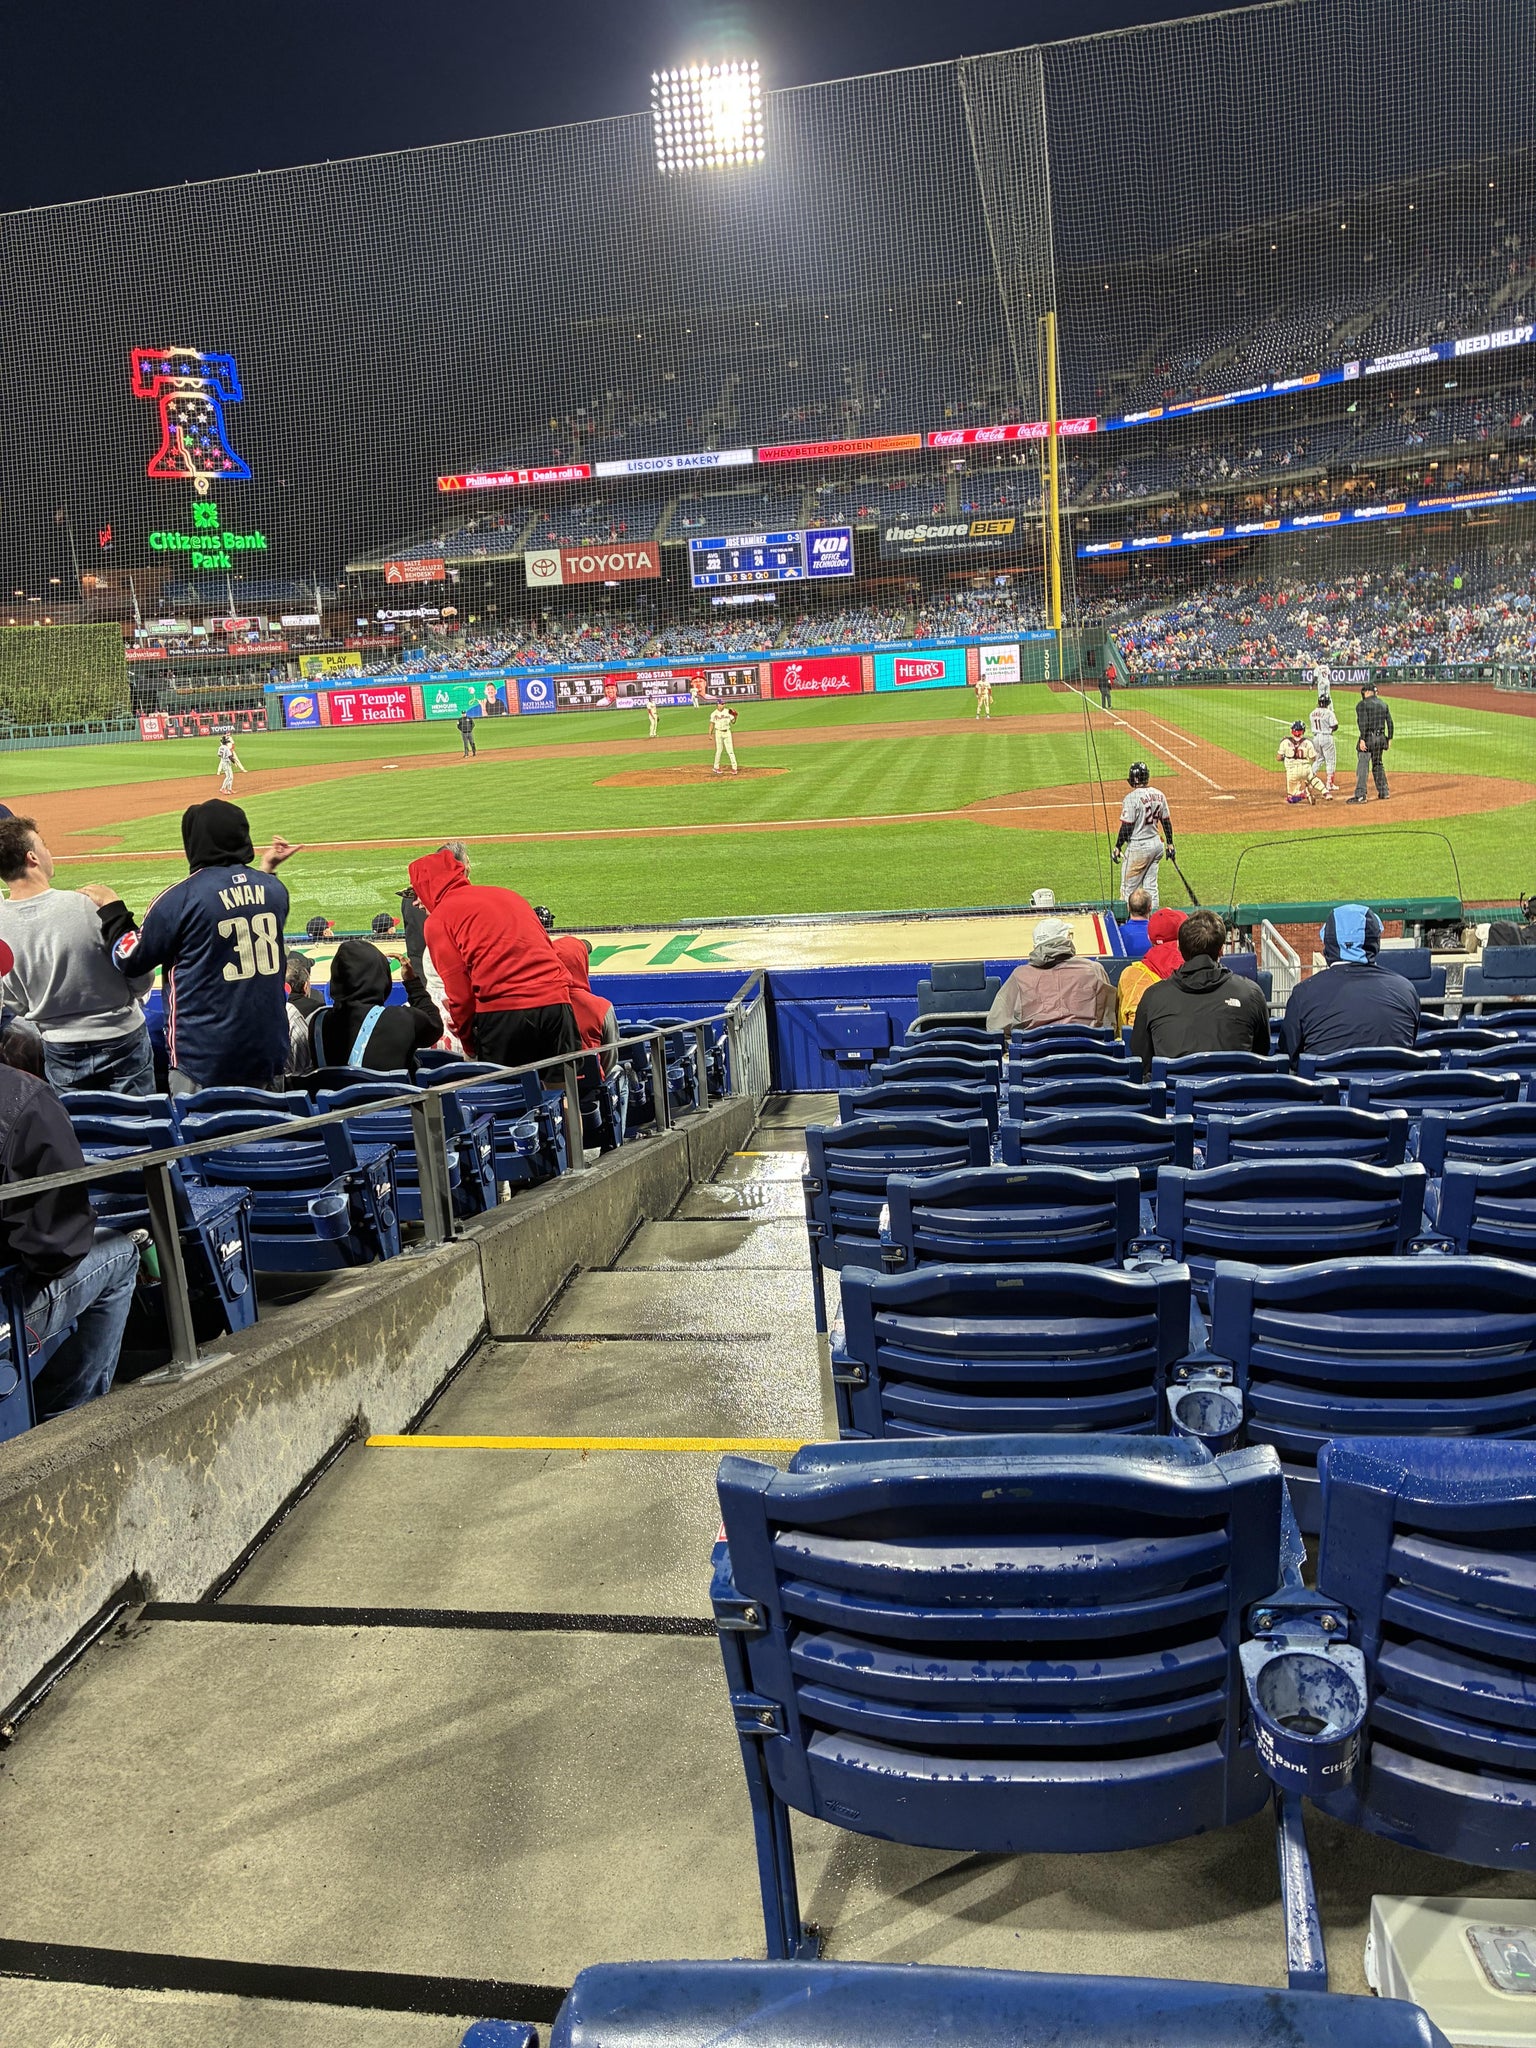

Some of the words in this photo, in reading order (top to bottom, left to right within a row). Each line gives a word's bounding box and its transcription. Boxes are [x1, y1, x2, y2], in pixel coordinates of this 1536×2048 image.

[1456, 335, 1489, 356] NEED
[1491, 326, 1534, 349] HELP?
[764, 449, 793, 458] WHEY
[796, 444, 830, 455] BETTER
[833, 441, 873, 452] PROTEIN
[628, 459, 673, 471] LISCIO'S
[677, 455, 720, 467] BAKERY
[533, 471, 557, 480] Deals
[558, 468, 573, 477] roll
[574, 468, 583, 476] in
[466, 476, 497, 487] Phillies
[498, 474, 514, 483] win
[1428, 497, 1454, 506] OFFICIAL
[787, 533, 800, 542] 0-3
[886, 523, 969, 542] theScore
[973, 521, 1012, 534] BET
[150, 532, 221, 550] Citizens
[223, 531, 267, 549] Bank
[812, 536, 849, 554] KDI
[192, 551, 232, 569] Park
[566, 551, 652, 574] TOYOTA
[754, 555, 764, 566] 24
[820, 553, 841, 561] OFFICE
[404, 565, 443, 573] MONGELUZZI
[813, 559, 849, 569] TECHNOLOGY
[362, 638, 395, 647] Budweiser
[980, 633, 1015, 641] Independence
[247, 644, 283, 652] Budweiser
[326, 656, 347, 665] PLAY
[985, 655, 1015, 666] WM
[637, 672, 653, 680] 2026
[653, 670, 673, 678] STATS
[899, 662, 940, 677] HERR'S
[729, 676, 737, 685] 12
[743, 675, 752, 684] 15
[783, 668, 851, 692] Chick-fil-A
[1348, 670, 1367, 682] LAW
[532, 686, 542, 695] R
[747, 685, 754, 694] 11
[359, 691, 407, 707] Temple
[362, 705, 406, 721] Health
[211, 725, 235, 733] TOYOTA
[1314, 719, 1322, 732] 11
[1144, 804, 1161, 826] 24
[218, 884, 265, 911] KWAN
[217, 912, 280, 982] 38
[1275, 1753, 1308, 1775] Bank
